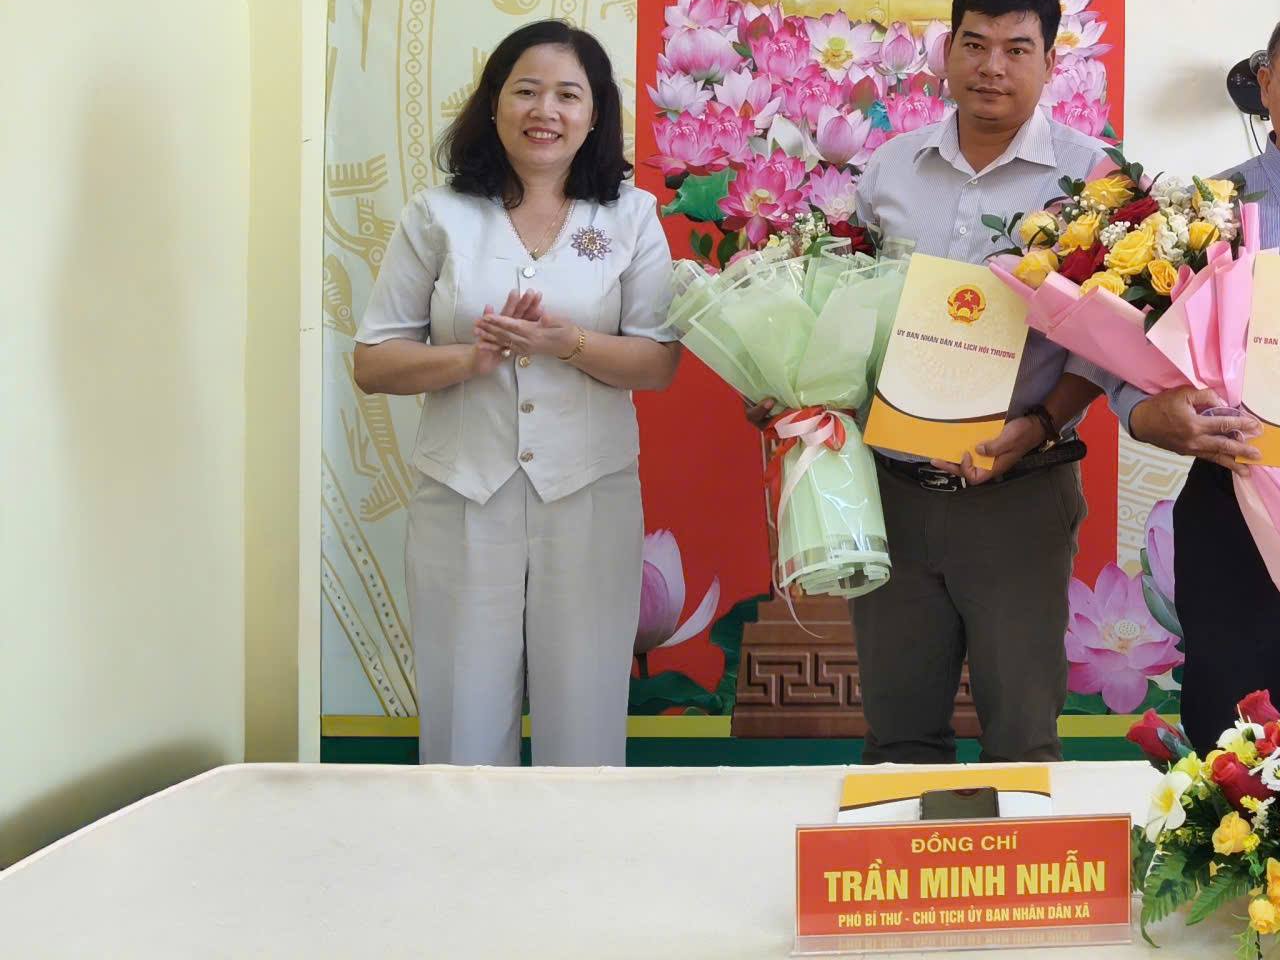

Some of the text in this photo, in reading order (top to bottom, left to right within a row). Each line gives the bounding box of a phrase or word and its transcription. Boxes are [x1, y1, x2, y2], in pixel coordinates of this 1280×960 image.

[906, 330, 920, 339] BAN
[1263, 337, 1278, 345] BAN
[911, 831, 1018, 854] ĐỒNG CHÍ
[824, 850, 1106, 903] TRẦN MINH NHẪN
[838, 911, 862, 928] PHÓ
[865, 911, 877, 927] BÍ
[880, 911, 902, 926] THƯ
[913, 906, 935, 925] CHỦ
[939, 910, 965, 926] TỊCH
[968, 905, 982, 923] ỦY
[986, 907, 1009, 922] BAN
[1013, 904, 1045, 921] NHÂN
[1047, 903, 1072, 920] DÂN
[1075, 902, 1090, 919] XÃ
